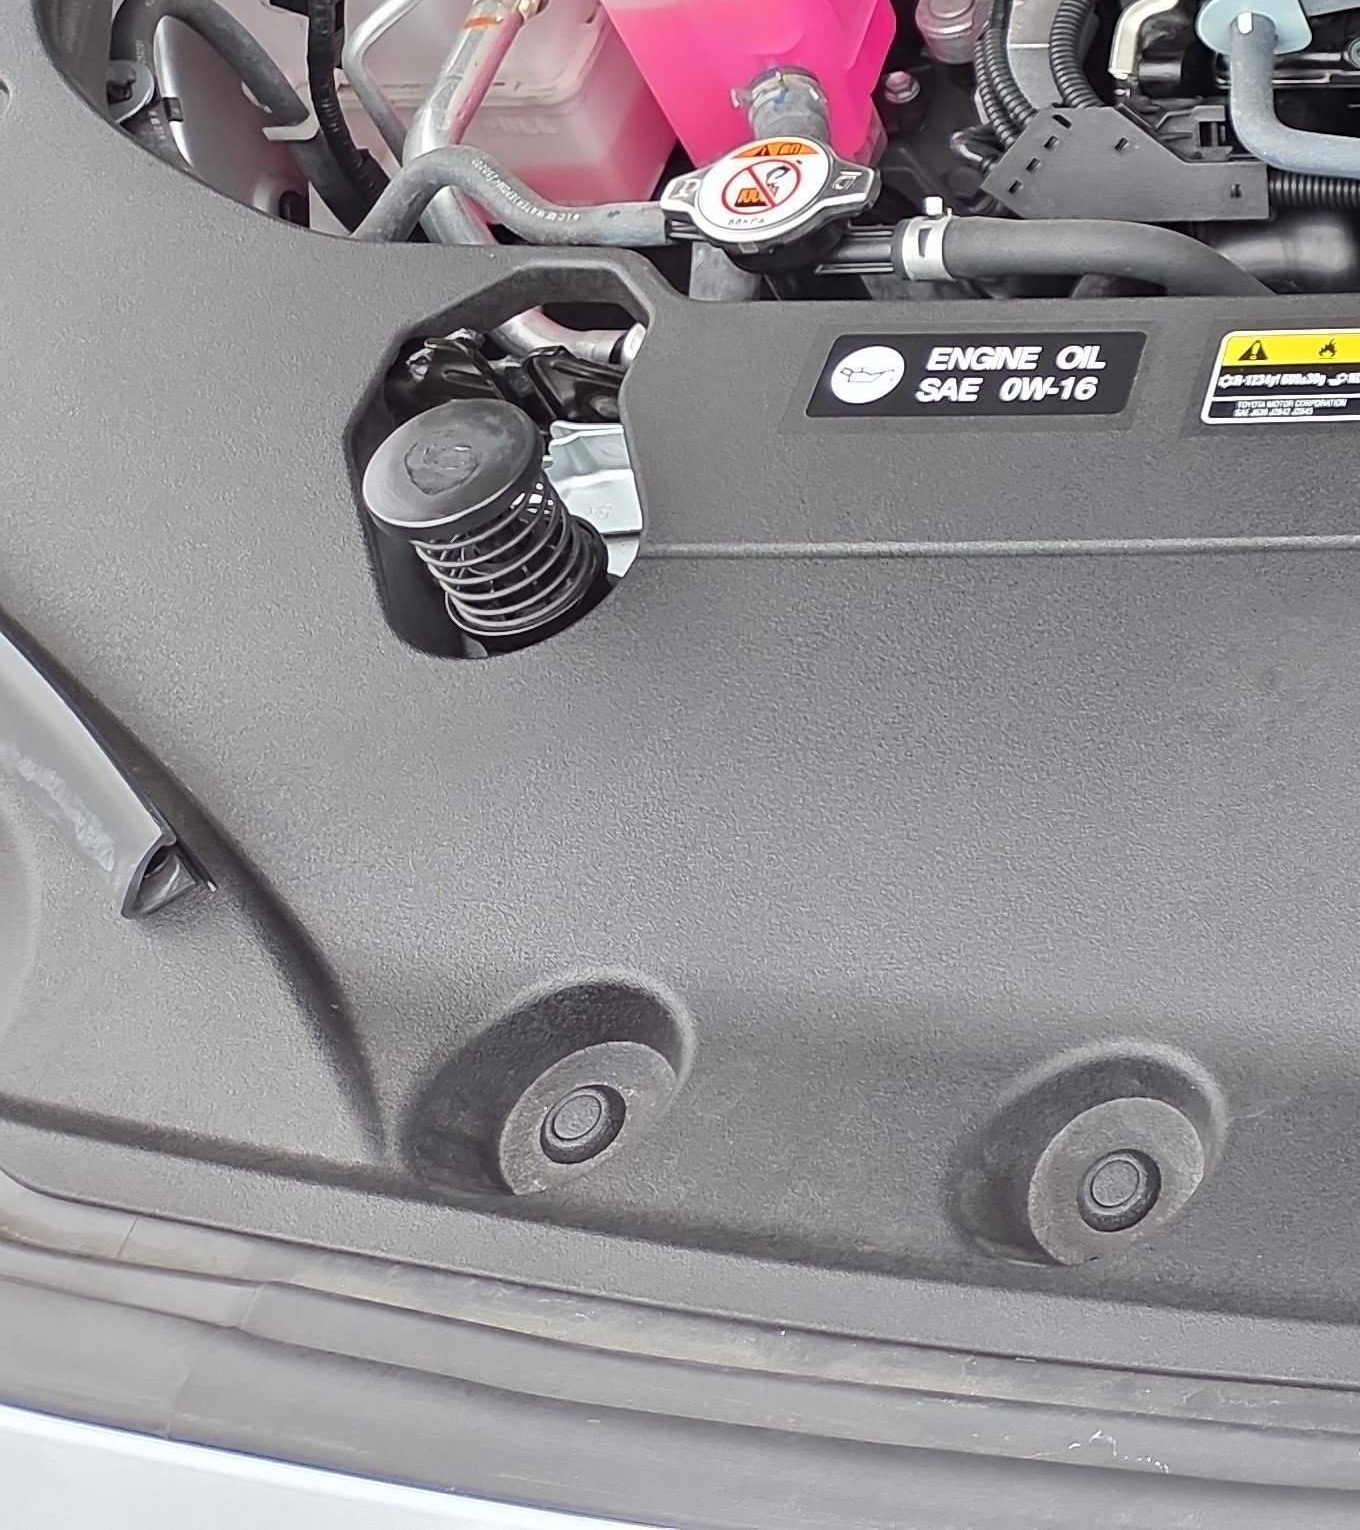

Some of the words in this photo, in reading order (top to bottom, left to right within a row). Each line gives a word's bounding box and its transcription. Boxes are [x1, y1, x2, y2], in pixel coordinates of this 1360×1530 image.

[926, 345, 1043, 371] ENGINE
[1055, 344, 1107, 370] OIL
[915, 377, 984, 402] SAE
[999, 376, 1099, 401] 0W-16
[1236, 400, 1266, 409] TOYOTA
